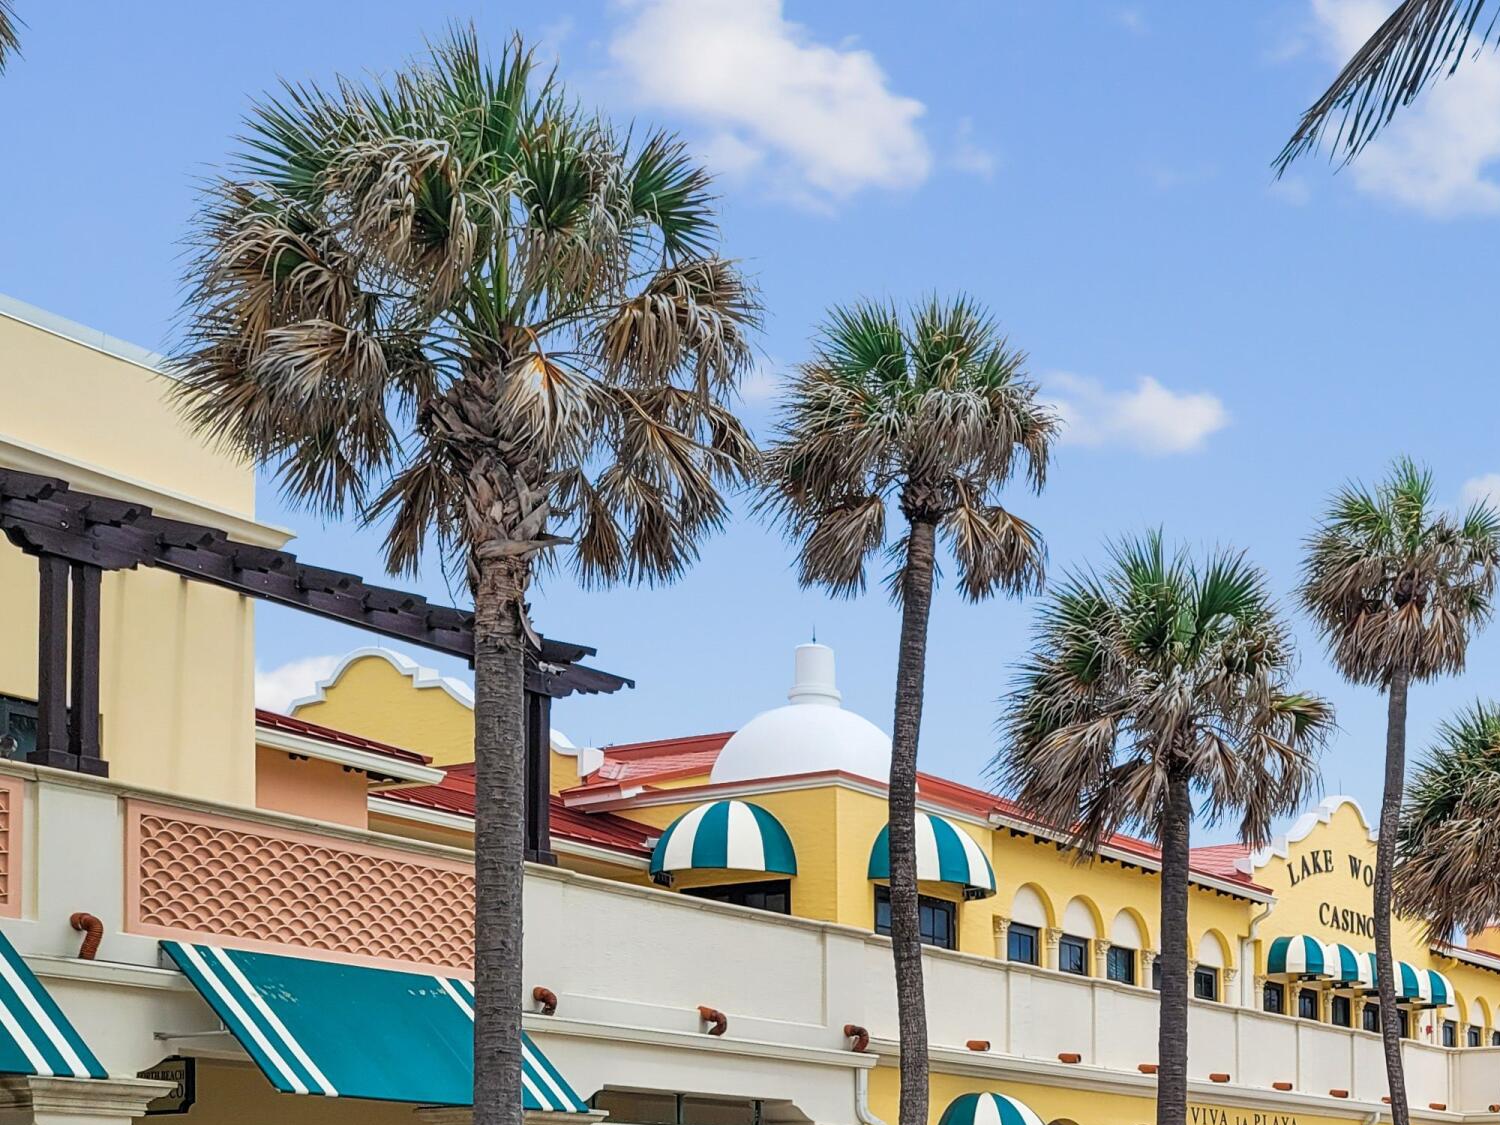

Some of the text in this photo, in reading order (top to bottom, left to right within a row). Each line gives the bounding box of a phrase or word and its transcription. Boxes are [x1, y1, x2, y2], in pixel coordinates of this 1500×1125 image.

[1287, 849, 1374, 888] LAKE WO
[1318, 902, 1376, 940] CASINO
